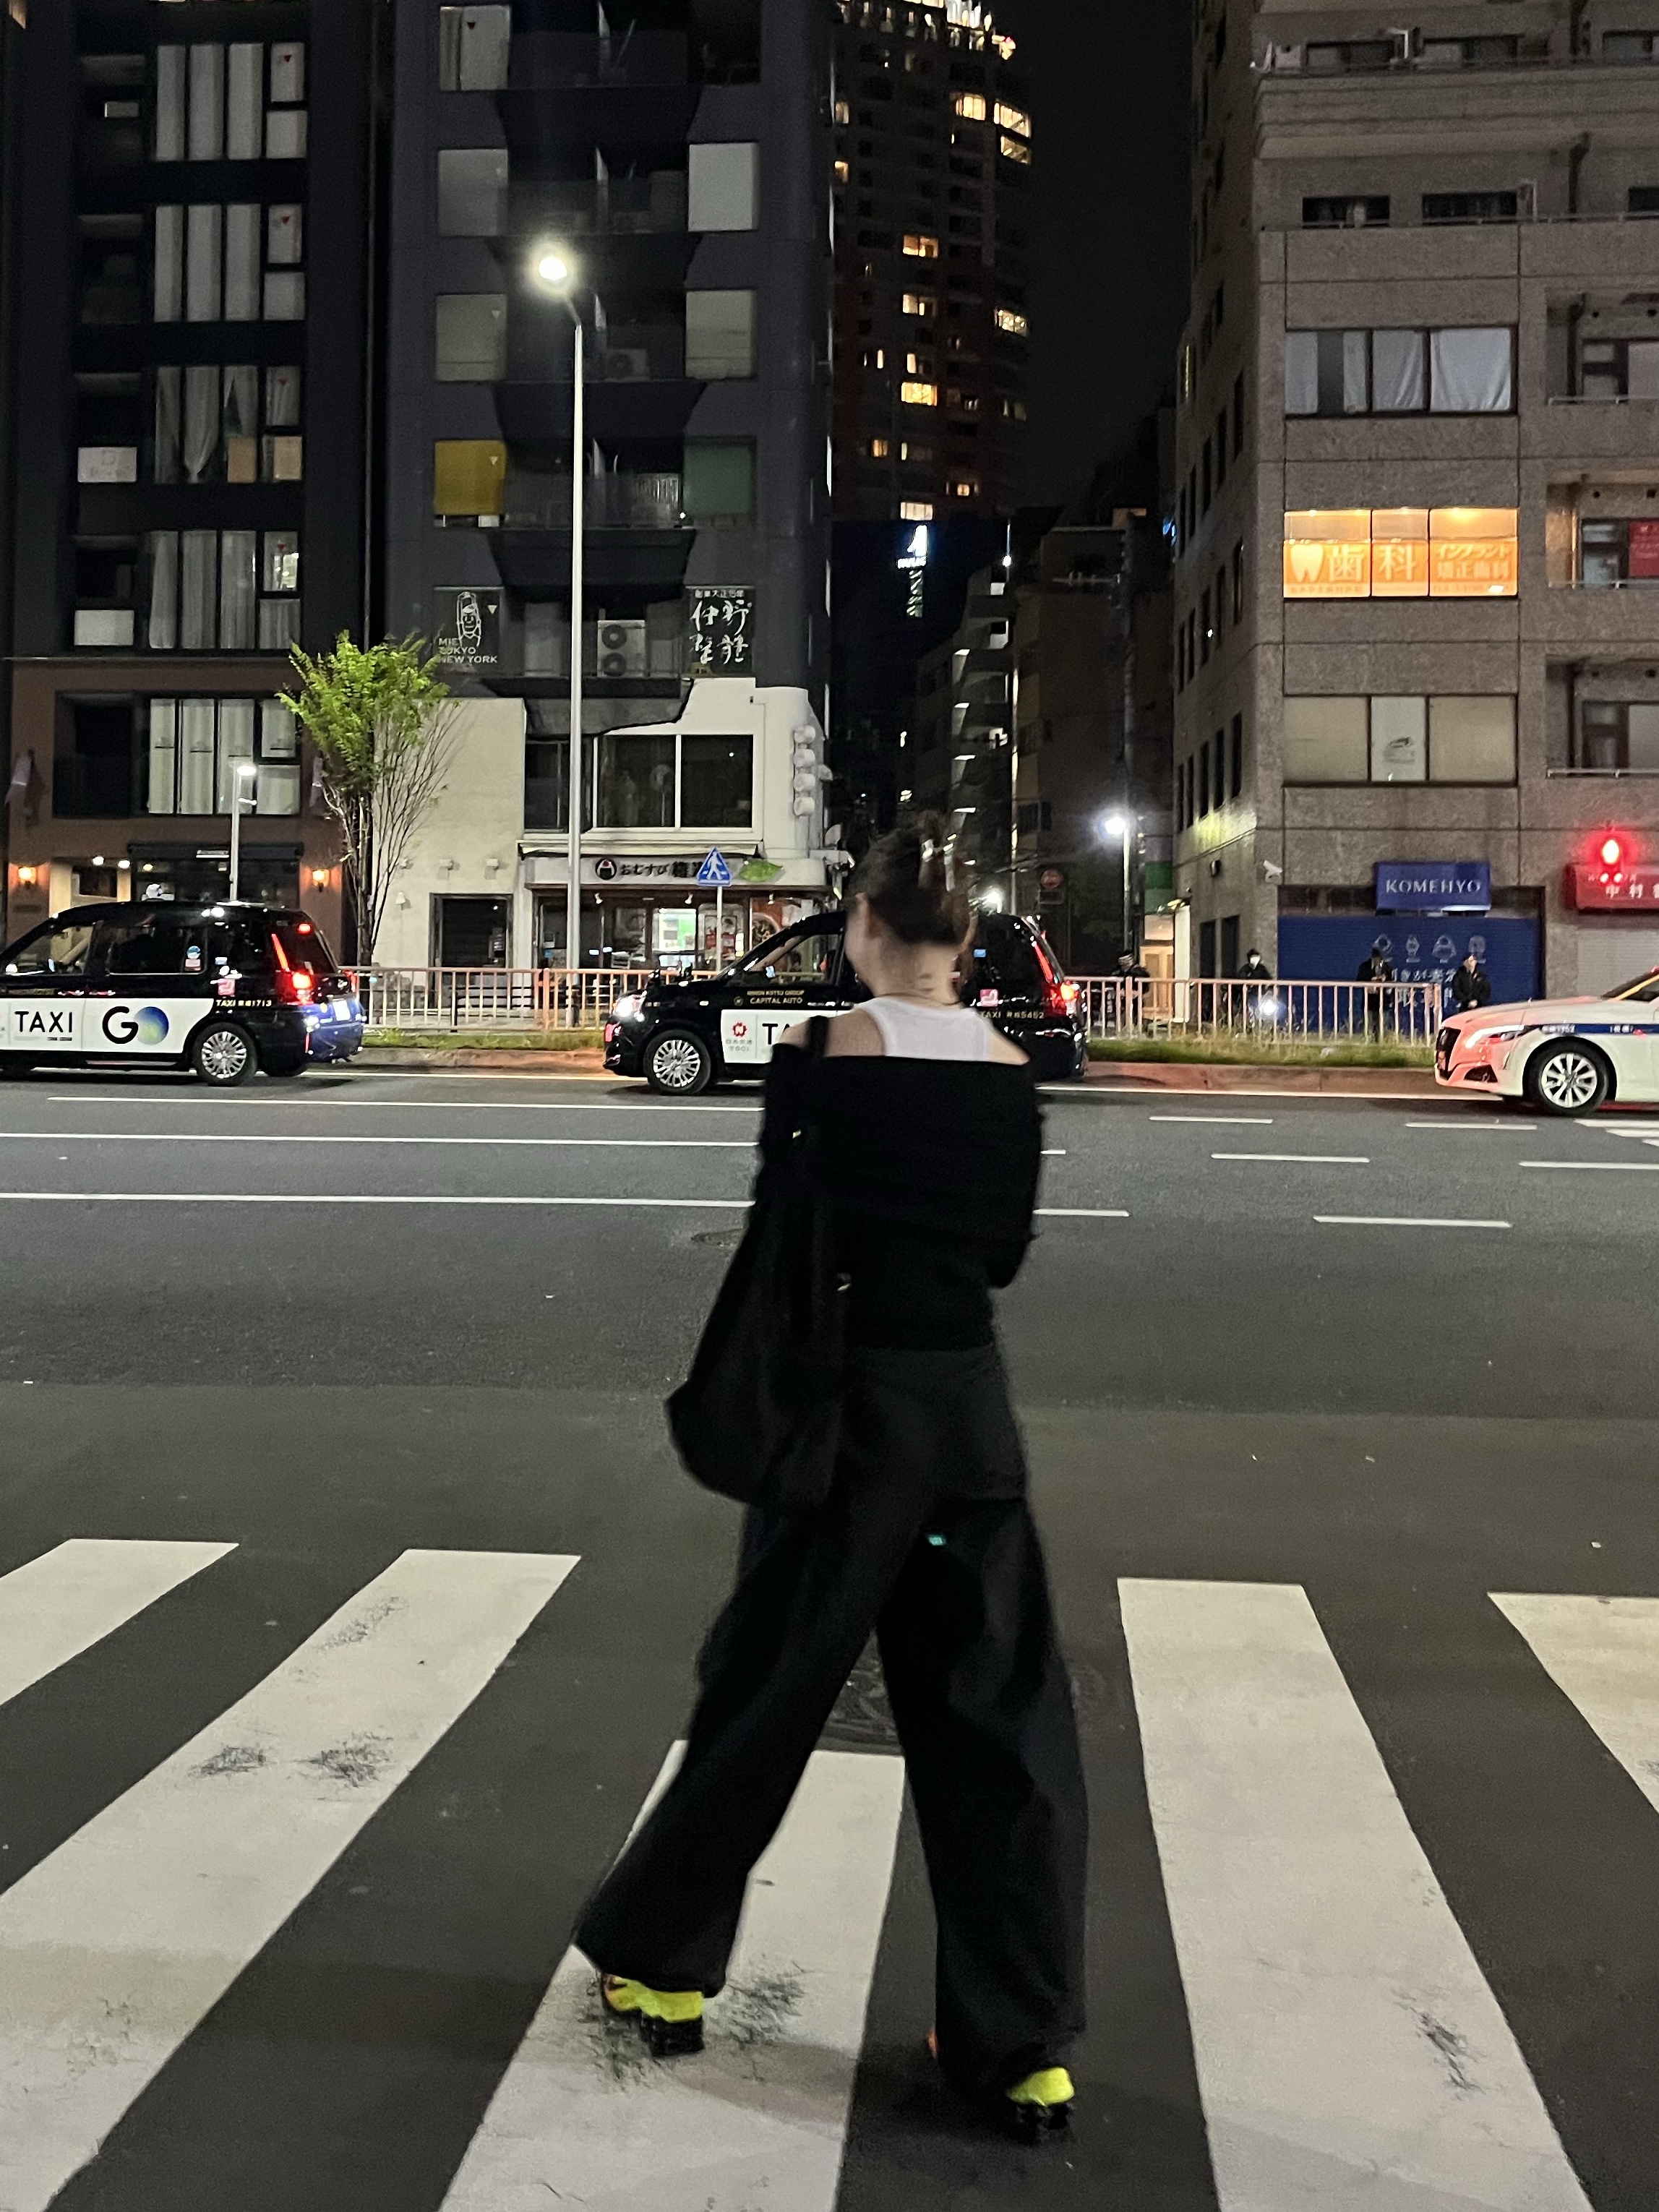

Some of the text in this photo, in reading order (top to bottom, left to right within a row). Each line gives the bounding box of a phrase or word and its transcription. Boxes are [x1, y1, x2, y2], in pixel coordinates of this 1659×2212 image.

[1327, 543, 1416, 582] 歯科
[467, 655, 498, 664] YORK
[1385, 878, 1482, 893] KOMEHYO
[14, 1011, 72, 1033] TAXI
